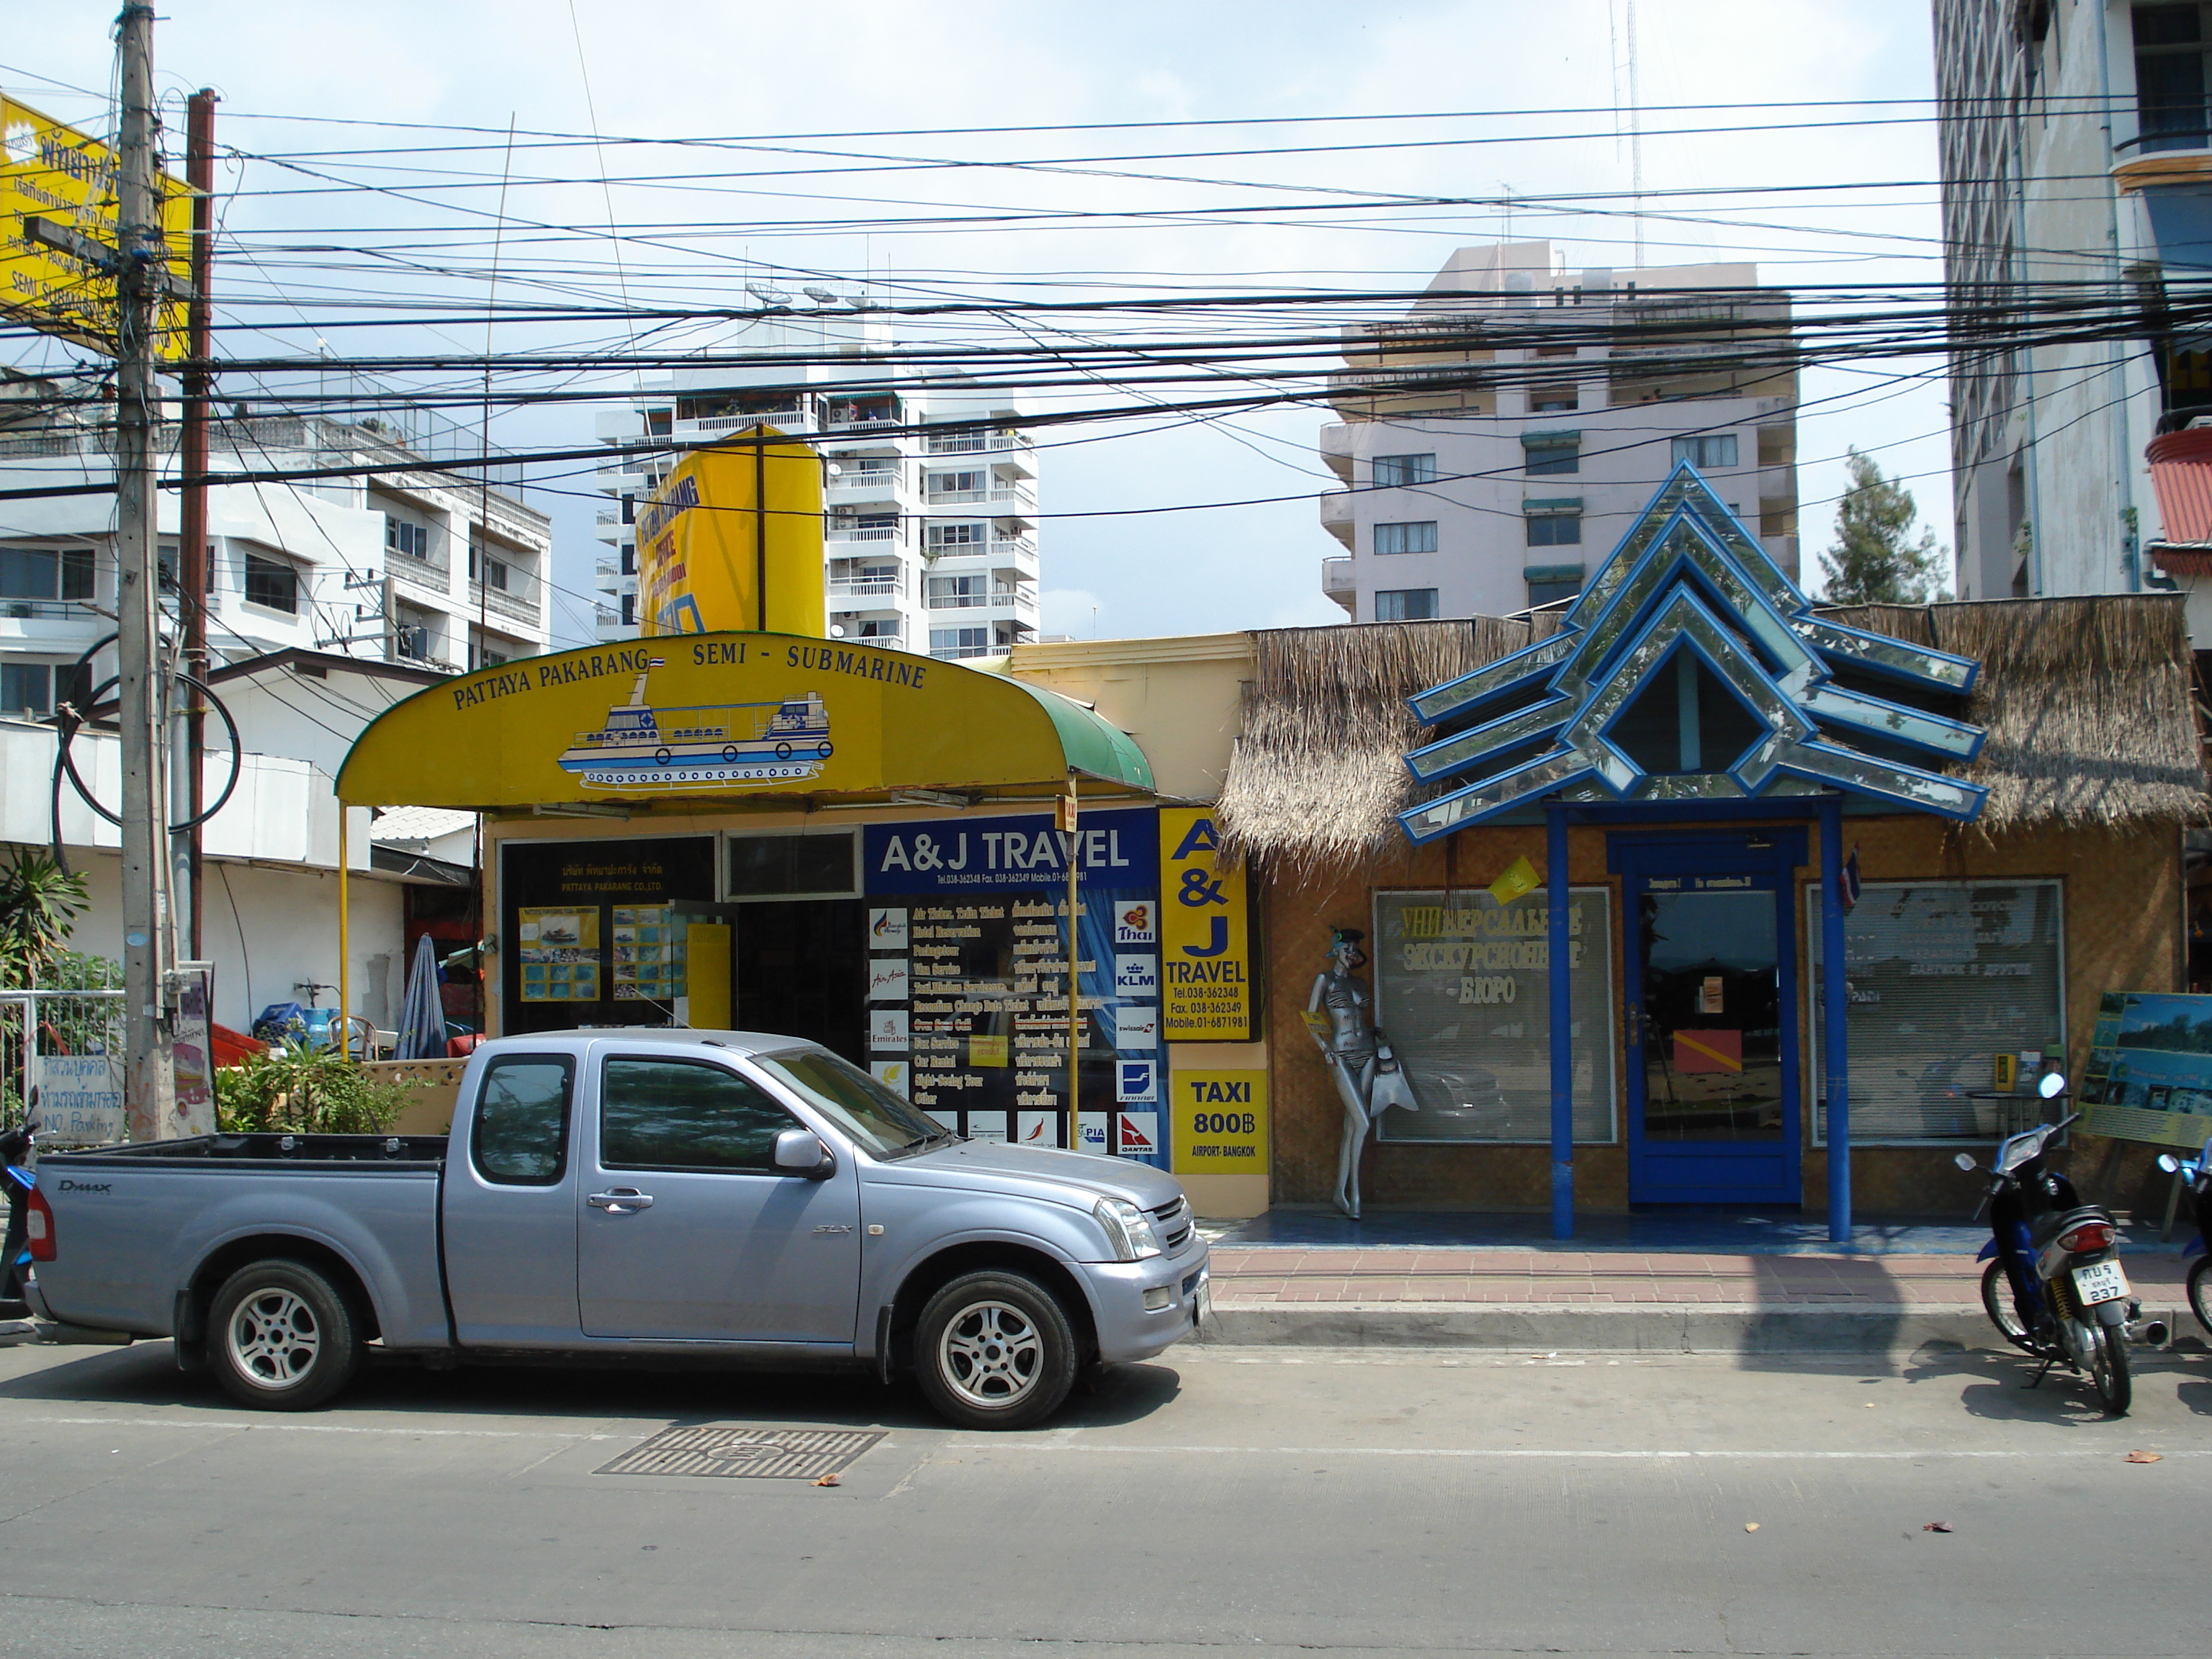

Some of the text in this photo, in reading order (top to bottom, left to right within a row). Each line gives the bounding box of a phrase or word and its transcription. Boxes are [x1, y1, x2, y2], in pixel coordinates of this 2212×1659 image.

[12, 269, 37, 298] SEMI
[693, 643, 746, 665] SEMI
[787, 645, 926, 689] SUBMARINE
[452, 648, 648, 711] PATTAYA PAKARANG
[880, 830, 1130, 872] A&J TRAVEL
[1030, 871, 1087, 884] Mobile.01-68981
[562, 883, 592, 892] PATTAYA
[595, 882, 631, 891] PAKARANG
[1178, 868, 1229, 907] &
[912, 907, 926, 920] Air
[956, 906, 978, 920] Train
[979, 905, 1004, 919] Ticket
[913, 925, 981, 938] Hotel Reservation
[1118, 926, 1152, 940] Thai
[1182, 916, 1228, 958] J
[913, 962, 961, 976] Visa Service
[1166, 961, 1246, 984] TRAVEL
[1118, 976, 1154, 986] KLM
[1173, 986, 1238, 998] Tel.038-362348
[1459, 976, 1516, 1004] БЮРО
[914, 997, 1030, 1015] Reconfirm Change Date Ticket
[1171, 1002, 1241, 1014] Fax. 038-362349
[1166, 1016, 1247, 1028] Mobile.01-6871981
[914, 1037, 930, 1050] Fax
[930, 1037, 959, 1050] Service
[914, 1055, 956, 1068] Car Rental
[964, 1074, 984, 1087] Tour
[914, 1092, 938, 1105] Other
[1191, 1082, 1250, 1102] TAXI
[71, 1111, 113, 1138] Parking
[1086, 1128, 1105, 1136] PIA
[1223, 1146, 1256, 1156] BANGKOK
[2090, 1285, 2119, 1302] 237
